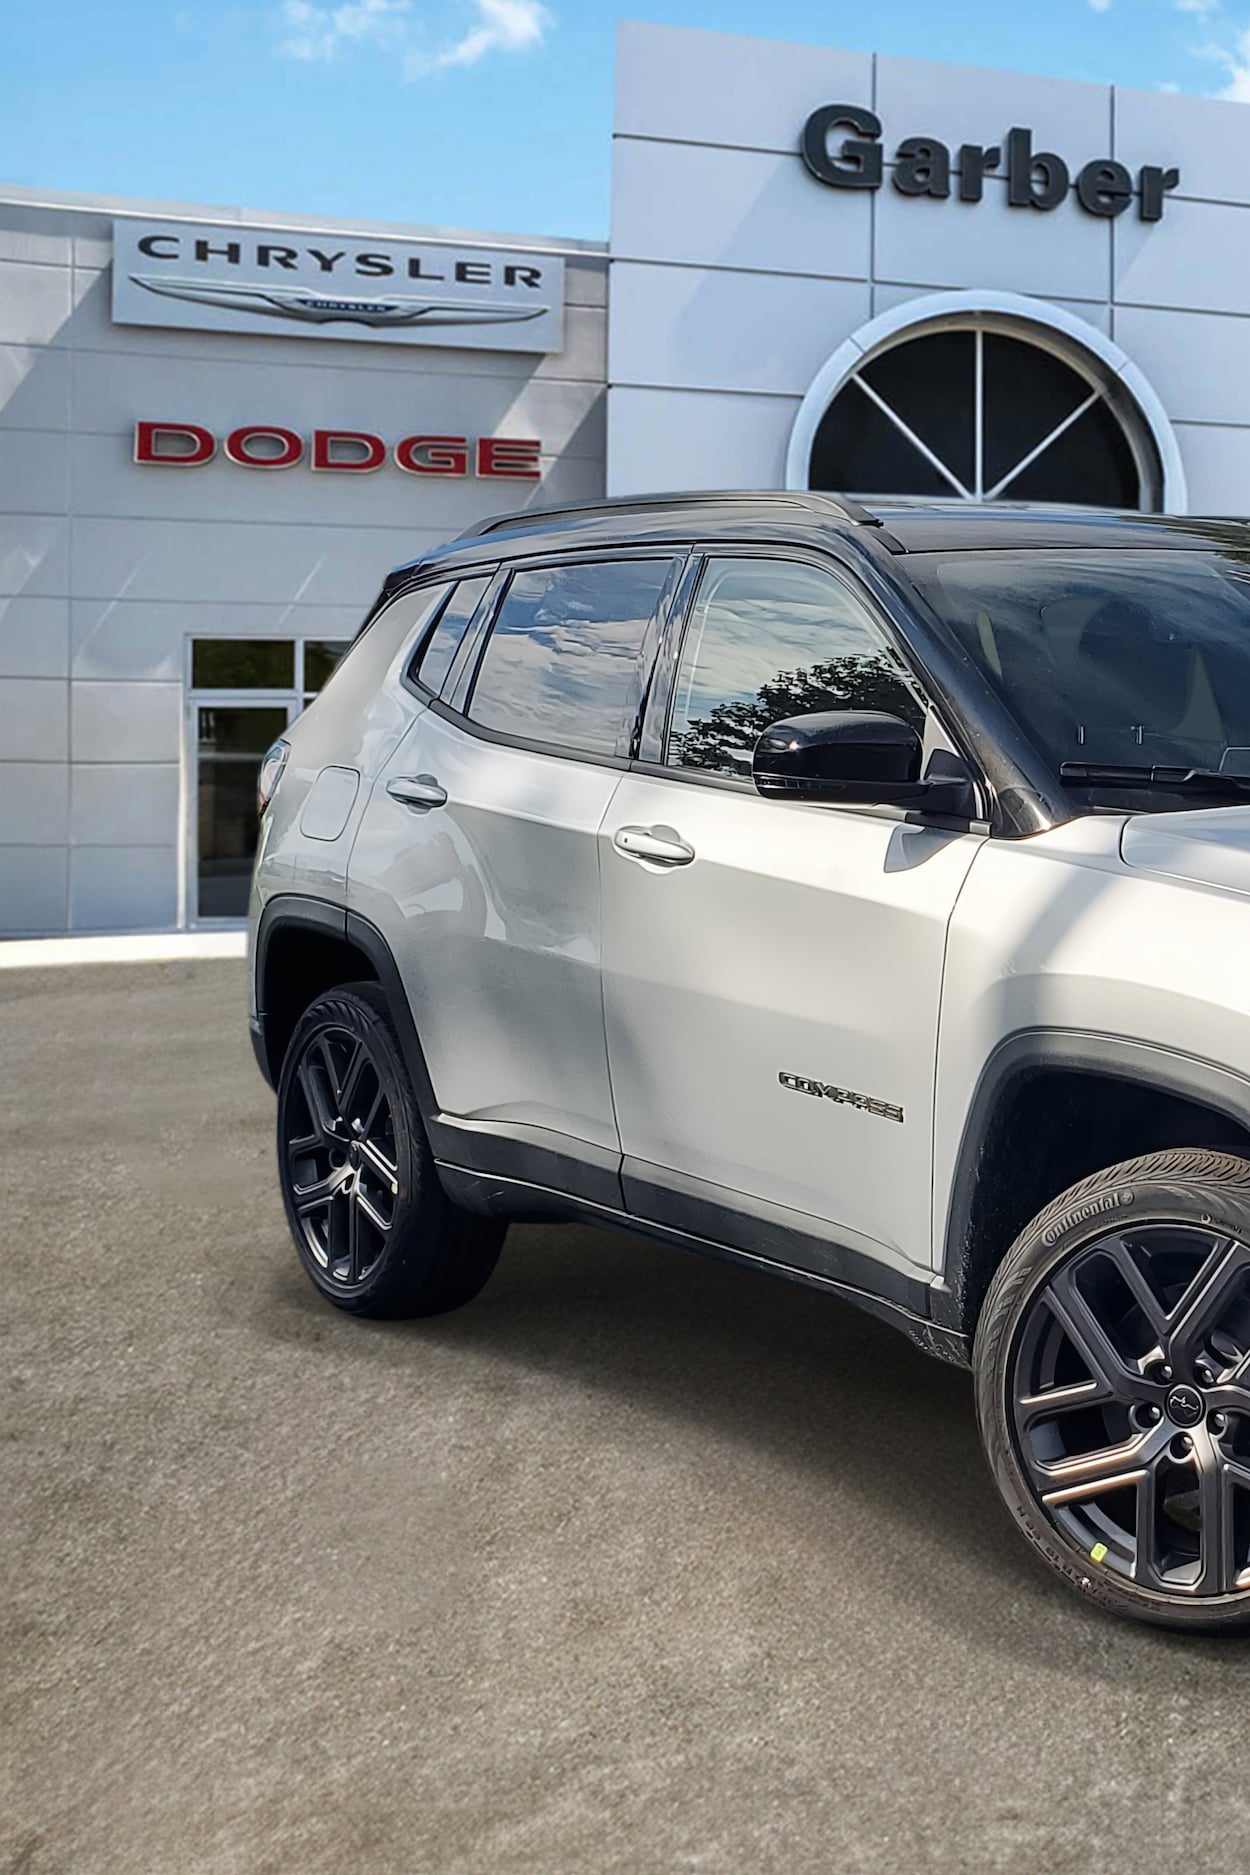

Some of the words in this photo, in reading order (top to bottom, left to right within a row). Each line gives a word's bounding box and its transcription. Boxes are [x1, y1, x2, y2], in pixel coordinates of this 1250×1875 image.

[802, 104, 1179, 222] Garber
[138, 235, 542, 288] CHRYSLER
[134, 421, 542, 480] DODGE
[779, 1071, 904, 1123] COMPASS
[1041, 1192, 1120, 1247] Continental
